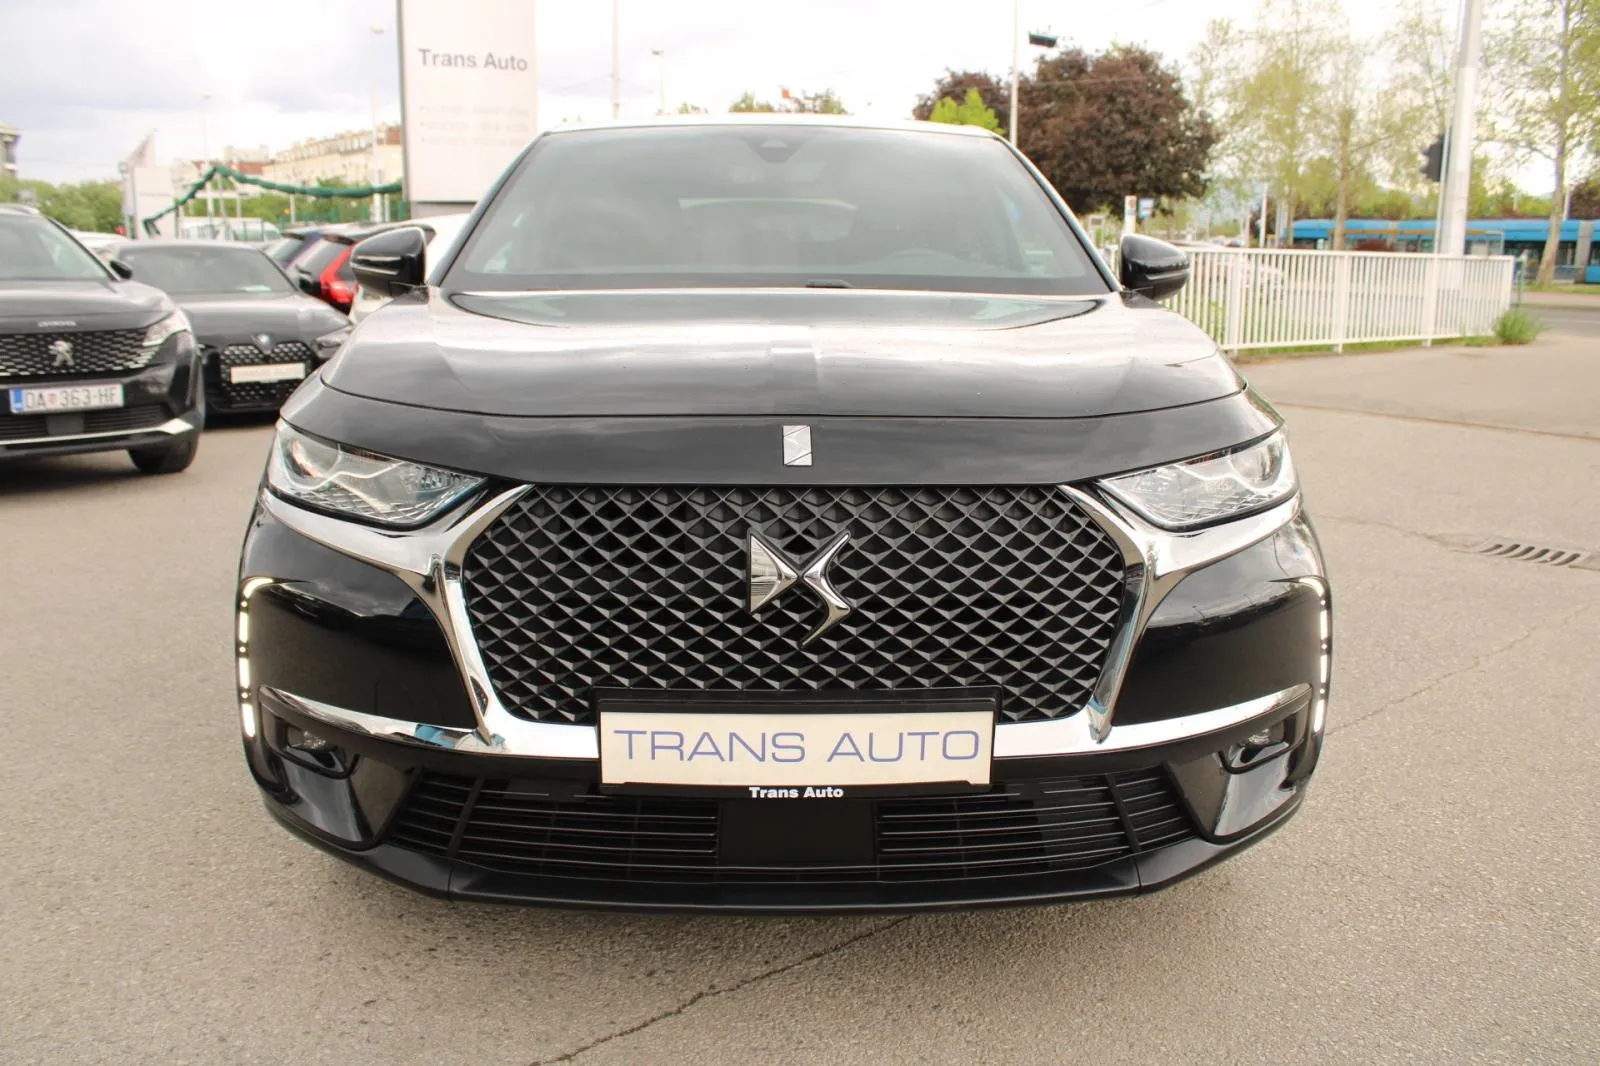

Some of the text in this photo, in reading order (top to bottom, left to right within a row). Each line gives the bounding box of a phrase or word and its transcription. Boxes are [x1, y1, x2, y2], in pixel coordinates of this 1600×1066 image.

[418, 48, 528, 72] Trans Auto
[613, 730, 980, 763] TRANS AUTO
[749, 786, 844, 799] Trans Auto
